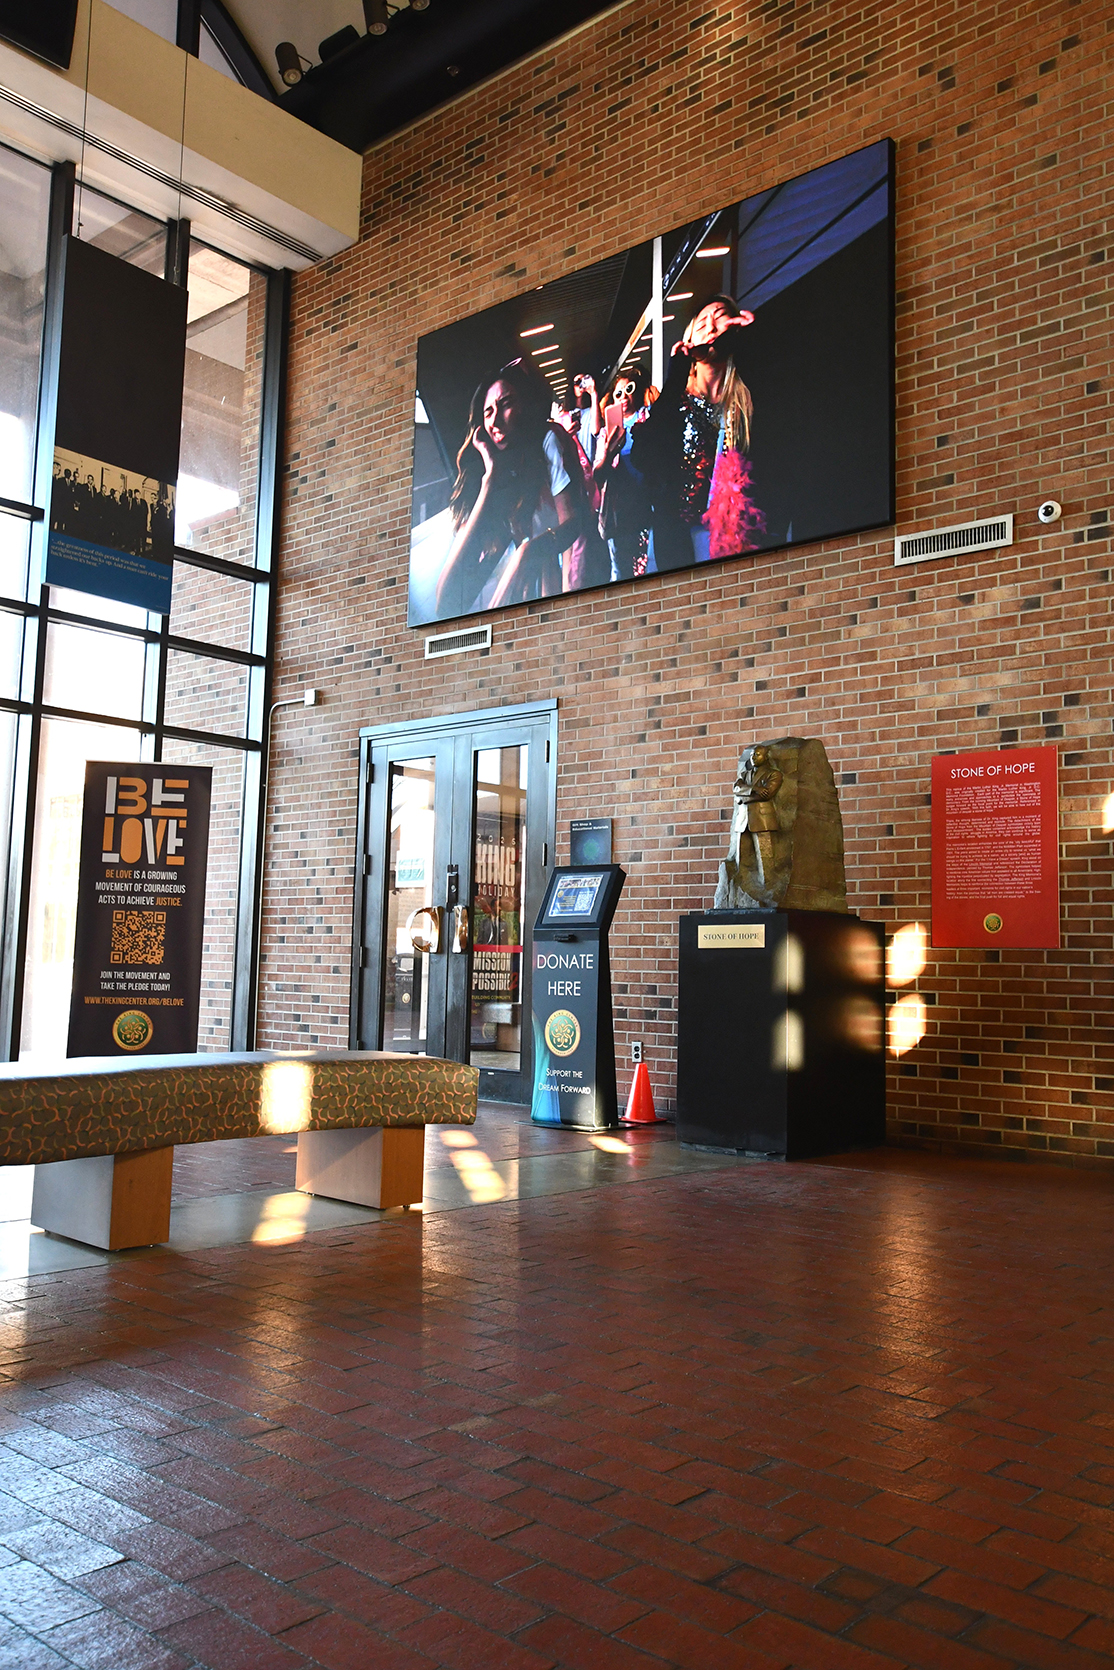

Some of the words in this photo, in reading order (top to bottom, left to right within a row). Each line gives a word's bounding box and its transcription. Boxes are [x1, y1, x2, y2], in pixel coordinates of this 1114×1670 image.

[950, 766, 984, 779] STONE
[986, 765, 1002, 776] OF
[1005, 762, 1035, 774] HOPE
[105, 776, 189, 817] BE
[102, 817, 187, 865] LOVE
[475, 843, 516, 886] KING
[105, 869, 114, 878] BE
[115, 869, 133, 879] LOVE
[133, 870, 140, 880] IS
[141, 870, 146, 880] A
[147, 871, 178, 881] GROWING
[95, 881, 133, 892] MOVEMENT
[134, 882, 142, 892] OF
[143, 883, 186, 894] COURAGEOUS
[98, 895, 115, 904] ACTS
[117, 895, 126, 905] TO
[126, 896, 154, 906] ACHIEVE
[155, 897, 183, 907] JUSTICE.
[738, 932, 760, 940] HOPE
[473, 951, 511, 971] MISSION
[536, 953, 594, 970] DONATE
[100, 971, 112, 979] JOIN
[113, 971, 125, 980] THE
[125, 972, 158, 981] MOVEMENT
[158, 973, 171, 981] AND
[472, 972, 511, 991] POSSIBLE
[100, 981, 115, 990] TAKE
[116, 982, 127, 991] THE
[128, 983, 149, 991] PLEDGE
[150, 983, 171, 992] TODAY!
[548, 981, 581, 996] HERE
[84, 996, 184, 1007] WWW.THEKINGCENTER.ORG/BELOVE
[546, 1068, 571, 1078] SUPPORT
[572, 1070, 583, 1079] THE
[538, 1082, 559, 1092] DREAM
[560, 1083, 591, 1095] FORWARD
